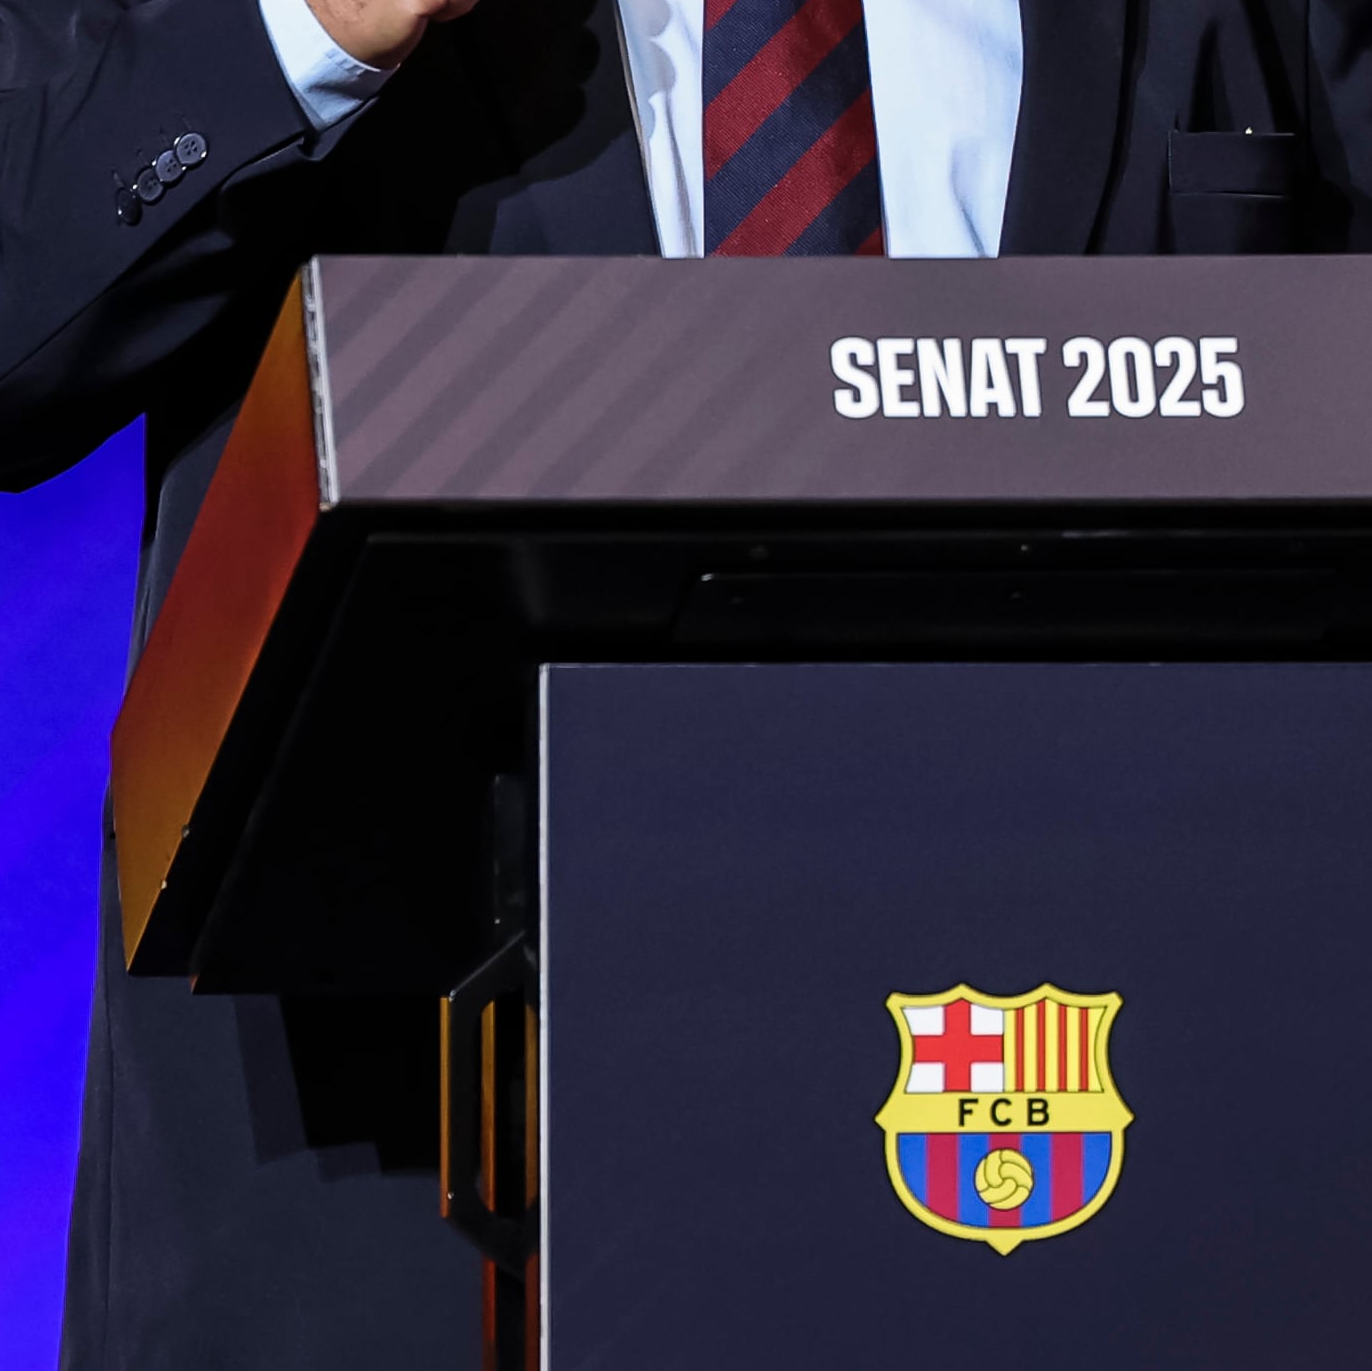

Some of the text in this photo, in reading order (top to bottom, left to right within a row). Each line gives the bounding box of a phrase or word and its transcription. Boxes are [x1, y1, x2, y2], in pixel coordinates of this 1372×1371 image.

[830, 336, 1245, 419] SENAT 2025
[958, 1097, 1050, 1127] FCB
